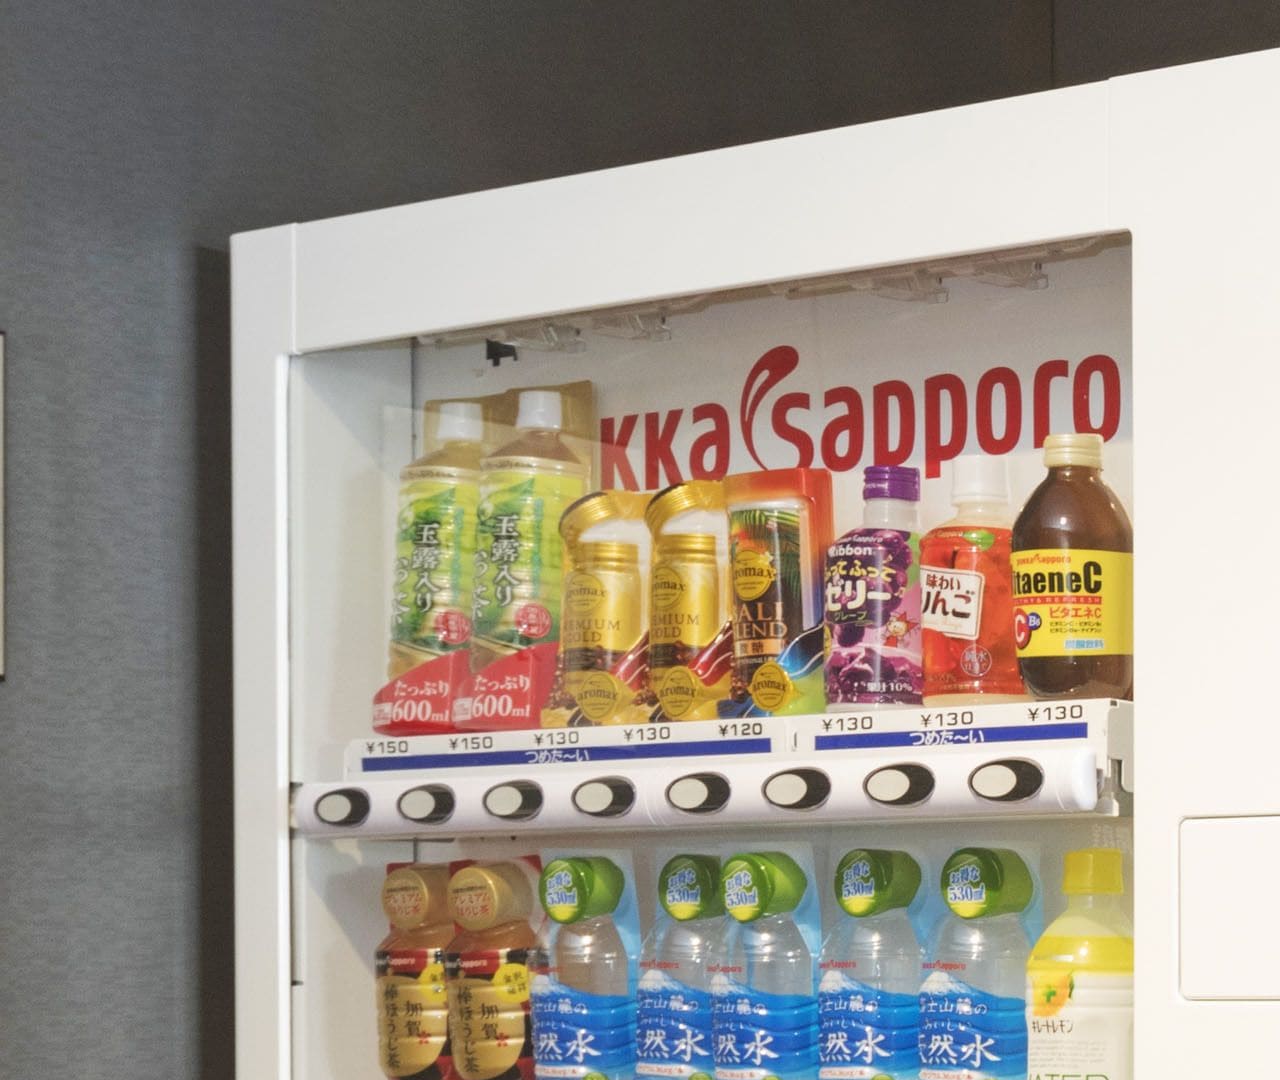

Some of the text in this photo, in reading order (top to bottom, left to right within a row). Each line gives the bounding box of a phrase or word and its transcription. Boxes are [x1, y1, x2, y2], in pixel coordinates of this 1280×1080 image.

[828, 545, 873, 557] Ribbon
[410, 523, 441, 613] 玉露入り
[491, 515, 521, 608] 玉露入り
[826, 579, 892, 611] ゼリー
[1049, 607, 1102, 619] ビタエネC
[394, 680, 449, 697] たっぷり
[474, 675, 530, 692] たっぷり
[392, 700, 449, 723] 600ml
[472, 695, 530, 718] 600ml
[1027, 705, 1083, 721] ¥130
[821, 716, 873, 732] ¥130
[920, 711, 974, 727] ¥130
[624, 727, 671, 742] ¥130
[719, 722, 763, 737] ¥120
[449, 736, 493, 750] ¥150
[534, 731, 579, 746] ¥130
[366, 740, 409, 754] ¥150
[404, 1001, 423, 1039] 加賀
[480, 1003, 499, 1041] 加賀
[637, 1029, 710, 1062] 然水
